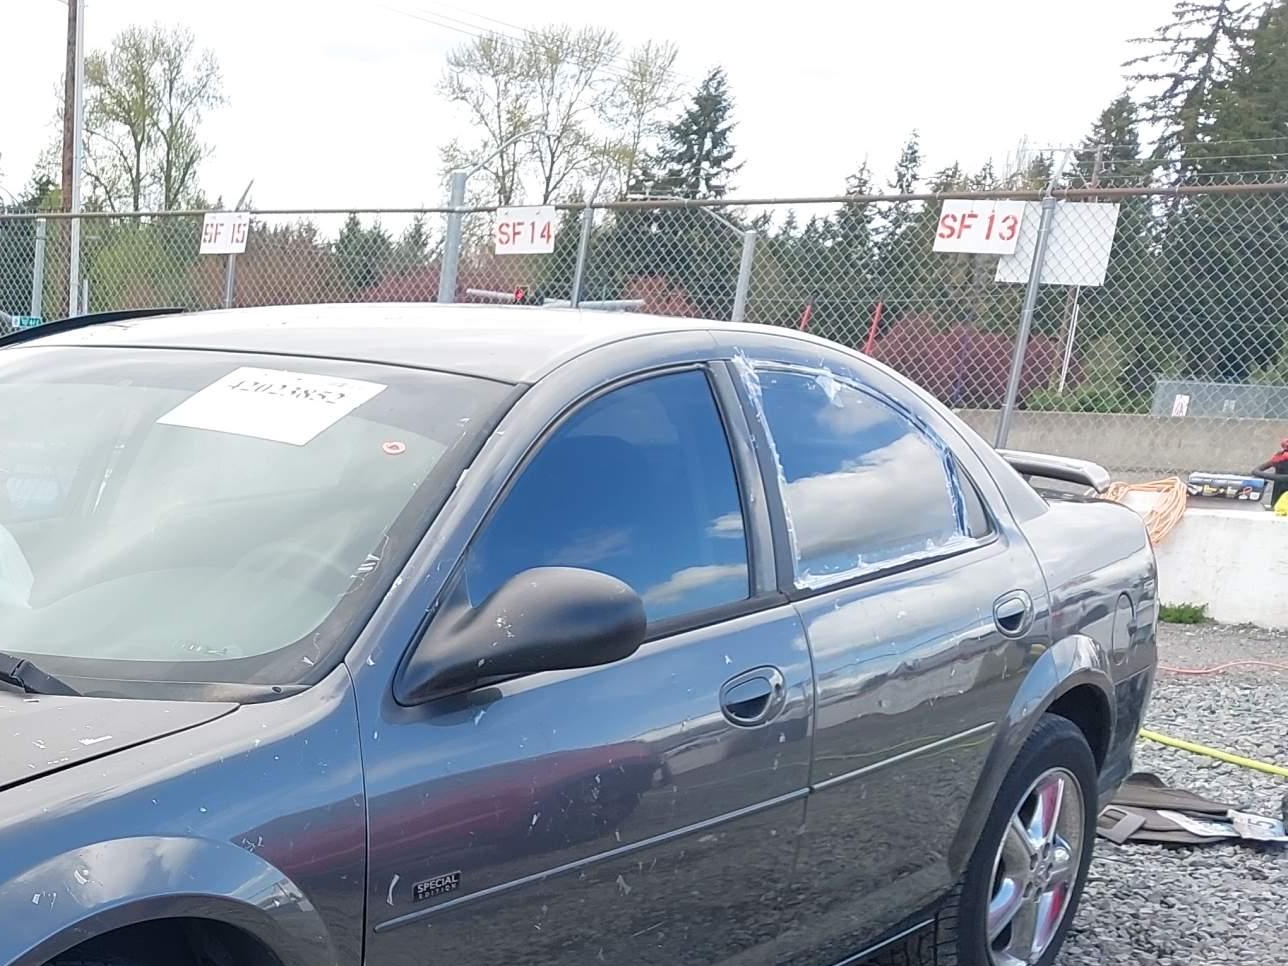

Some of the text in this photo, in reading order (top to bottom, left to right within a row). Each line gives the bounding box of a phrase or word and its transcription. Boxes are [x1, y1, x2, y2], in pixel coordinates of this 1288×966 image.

[202, 223, 247, 244] SF 15
[498, 221, 552, 245] SF 14
[938, 213, 1018, 240] SF 13
[227, 379, 346, 405] 42023852
[417, 875, 458, 893] SPECIAL
